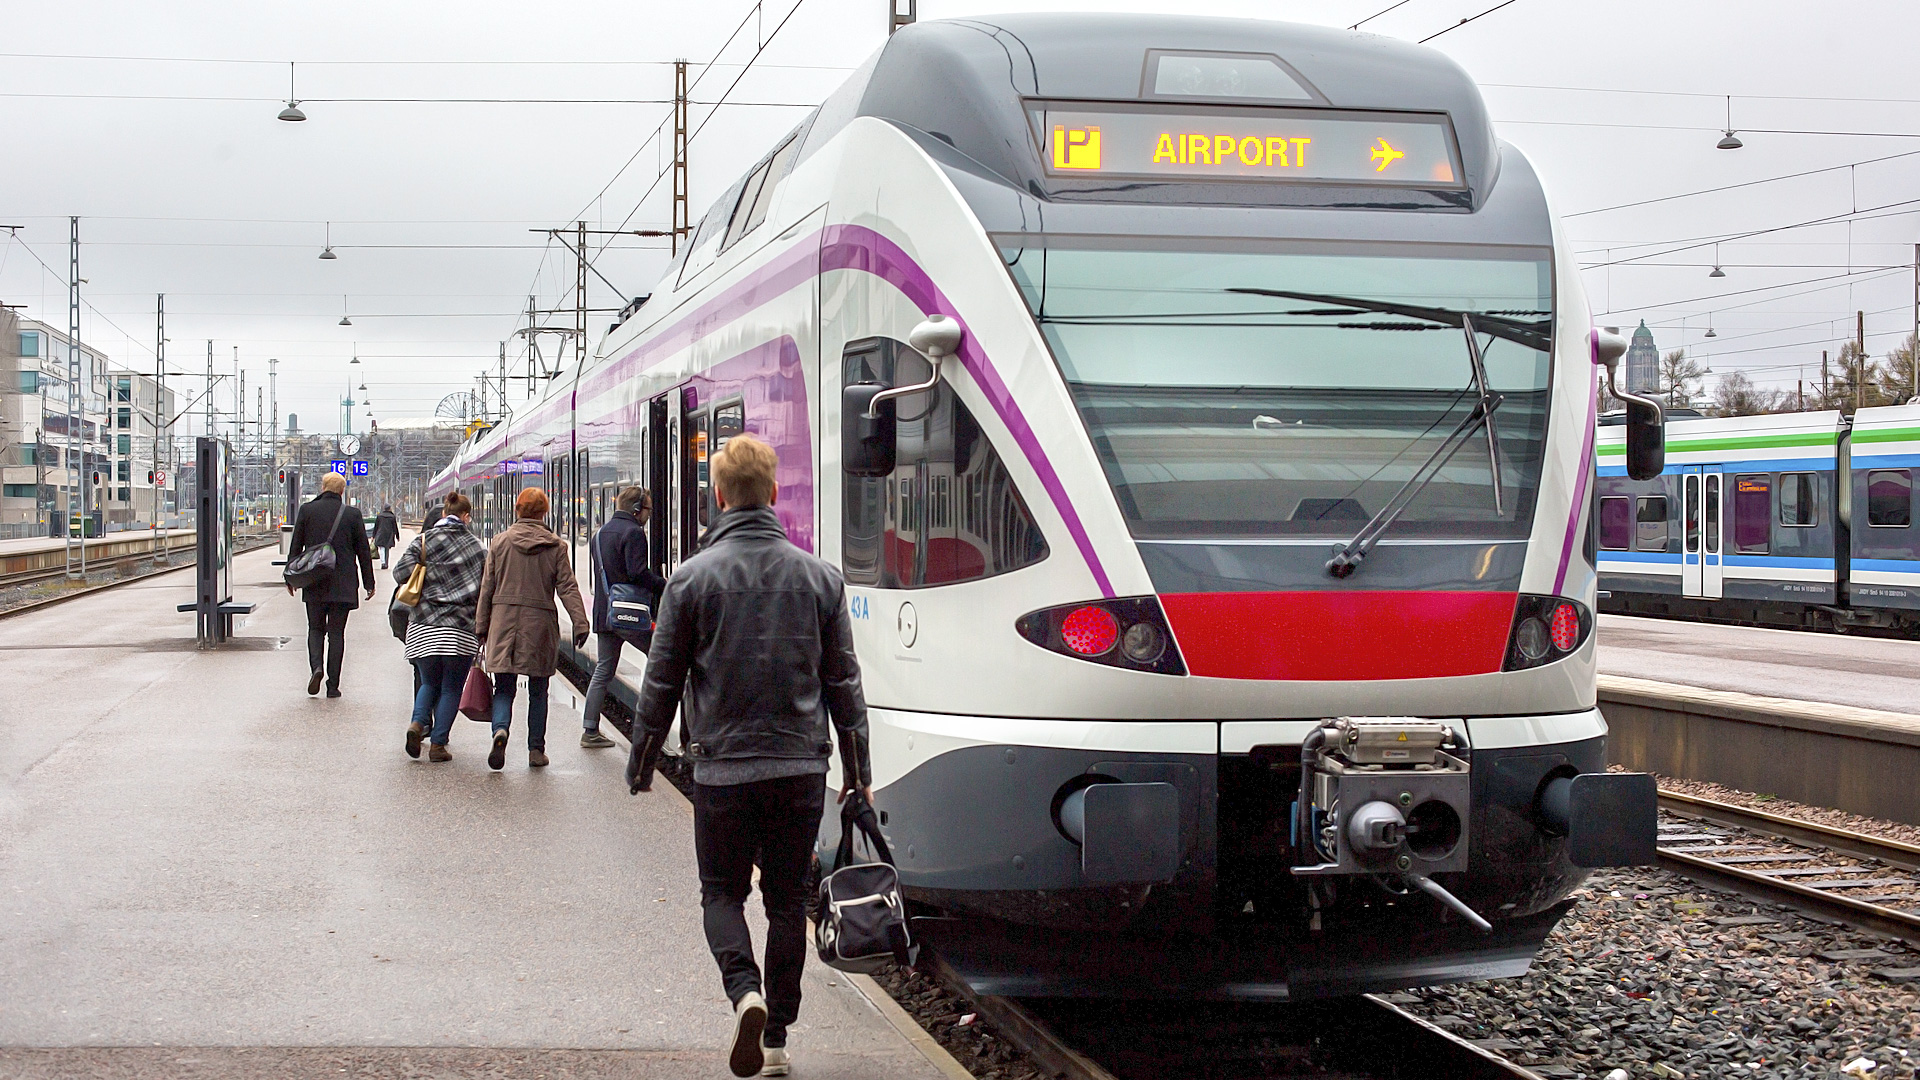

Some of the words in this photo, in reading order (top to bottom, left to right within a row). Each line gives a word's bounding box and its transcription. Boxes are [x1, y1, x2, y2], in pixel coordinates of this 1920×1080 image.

[1062, 127, 1091, 164] P
[1153, 133, 1311, 167] AIRPORT
[331, 462, 345, 473] 16
[353, 464, 368, 473] 15
[851, 595, 861, 619] 43
[862, 596, 869, 620] A
[617, 614, 639, 623] adidas
